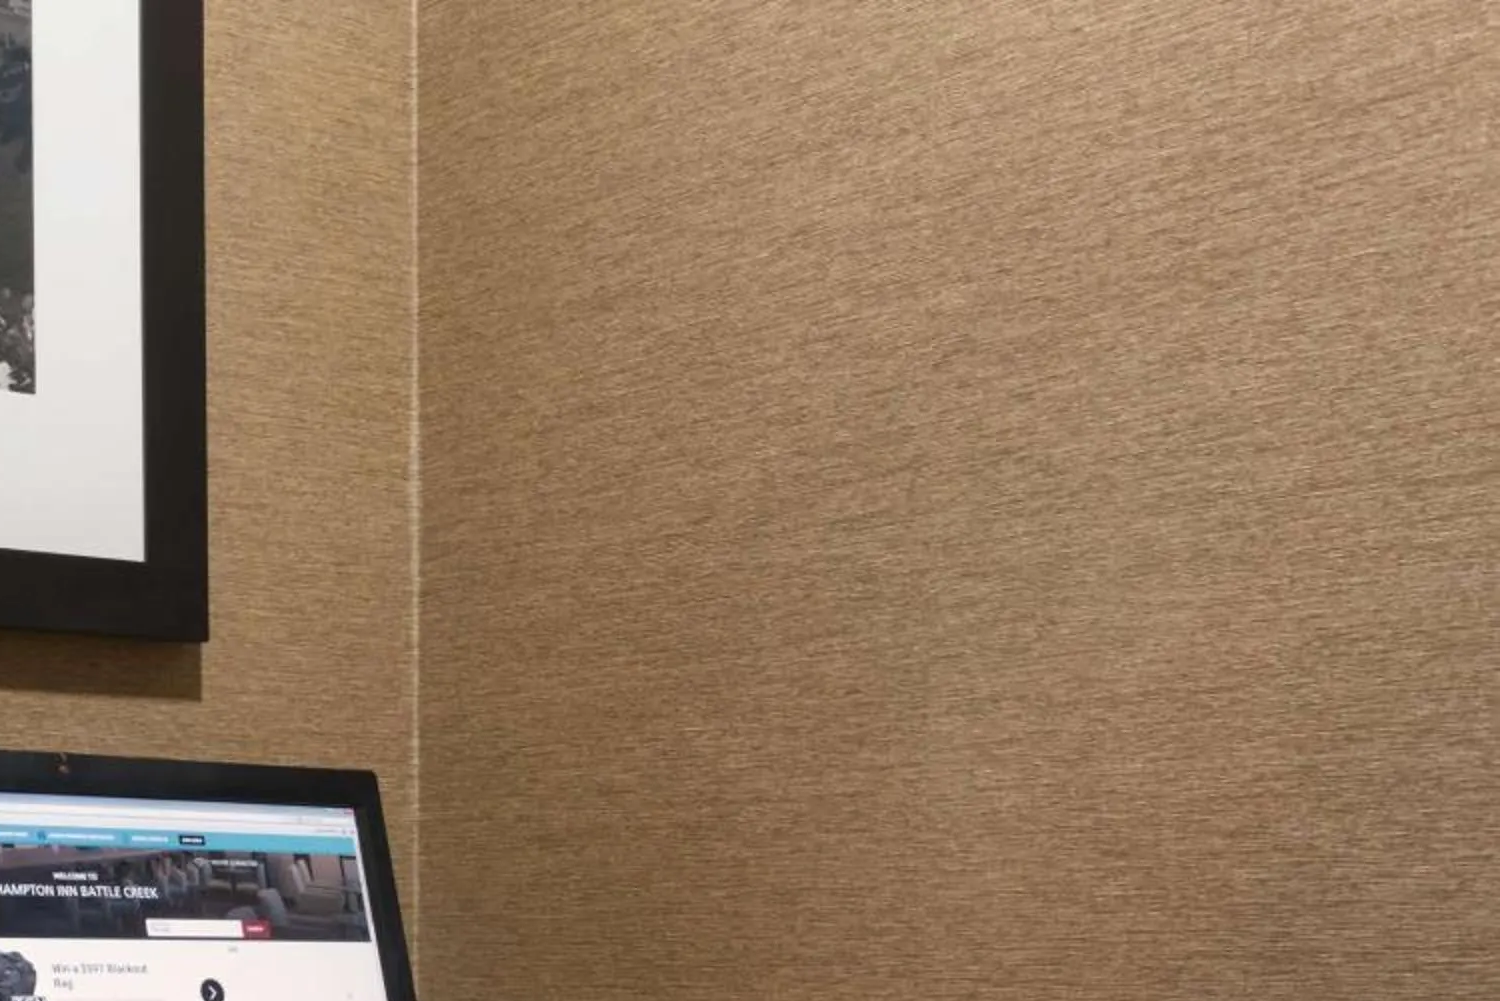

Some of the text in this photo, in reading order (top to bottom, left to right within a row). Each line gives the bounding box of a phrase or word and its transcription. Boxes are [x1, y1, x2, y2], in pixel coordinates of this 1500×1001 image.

[56, 885, 78, 897] INN
[81, 886, 121, 898] BATTLE
[123, 887, 158, 899] CREEK
